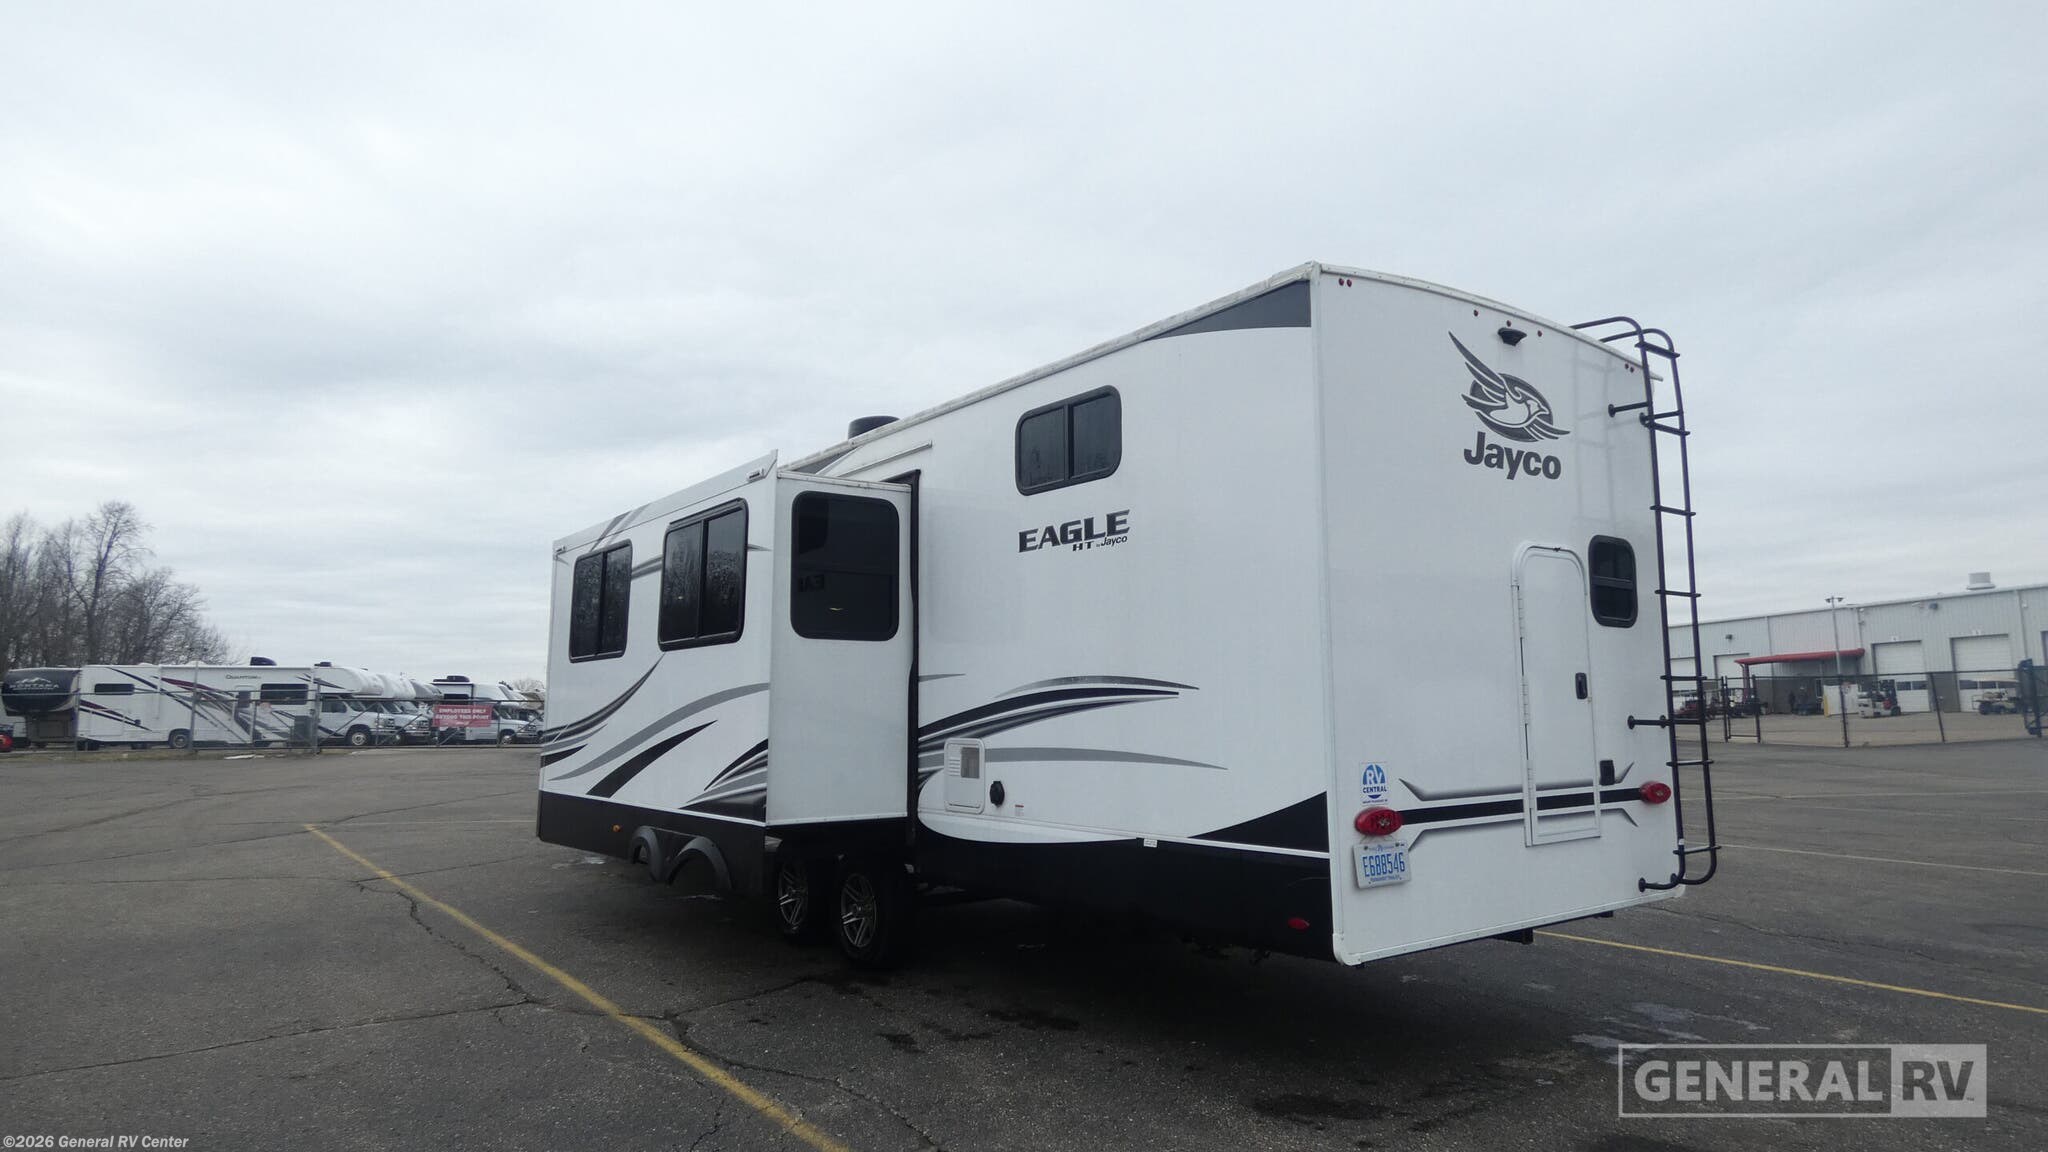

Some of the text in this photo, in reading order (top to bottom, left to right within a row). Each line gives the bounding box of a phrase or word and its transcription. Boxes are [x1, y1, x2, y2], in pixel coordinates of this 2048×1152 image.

[1463, 430, 1562, 481] Jayco
[1018, 509, 1130, 553] EAGLE
[1072, 540, 1095, 552] HT
[1101, 535, 1128, 547] Jayco
[1366, 764, 1383, 785] RV
[1362, 786, 1388, 794] CENTRAL
